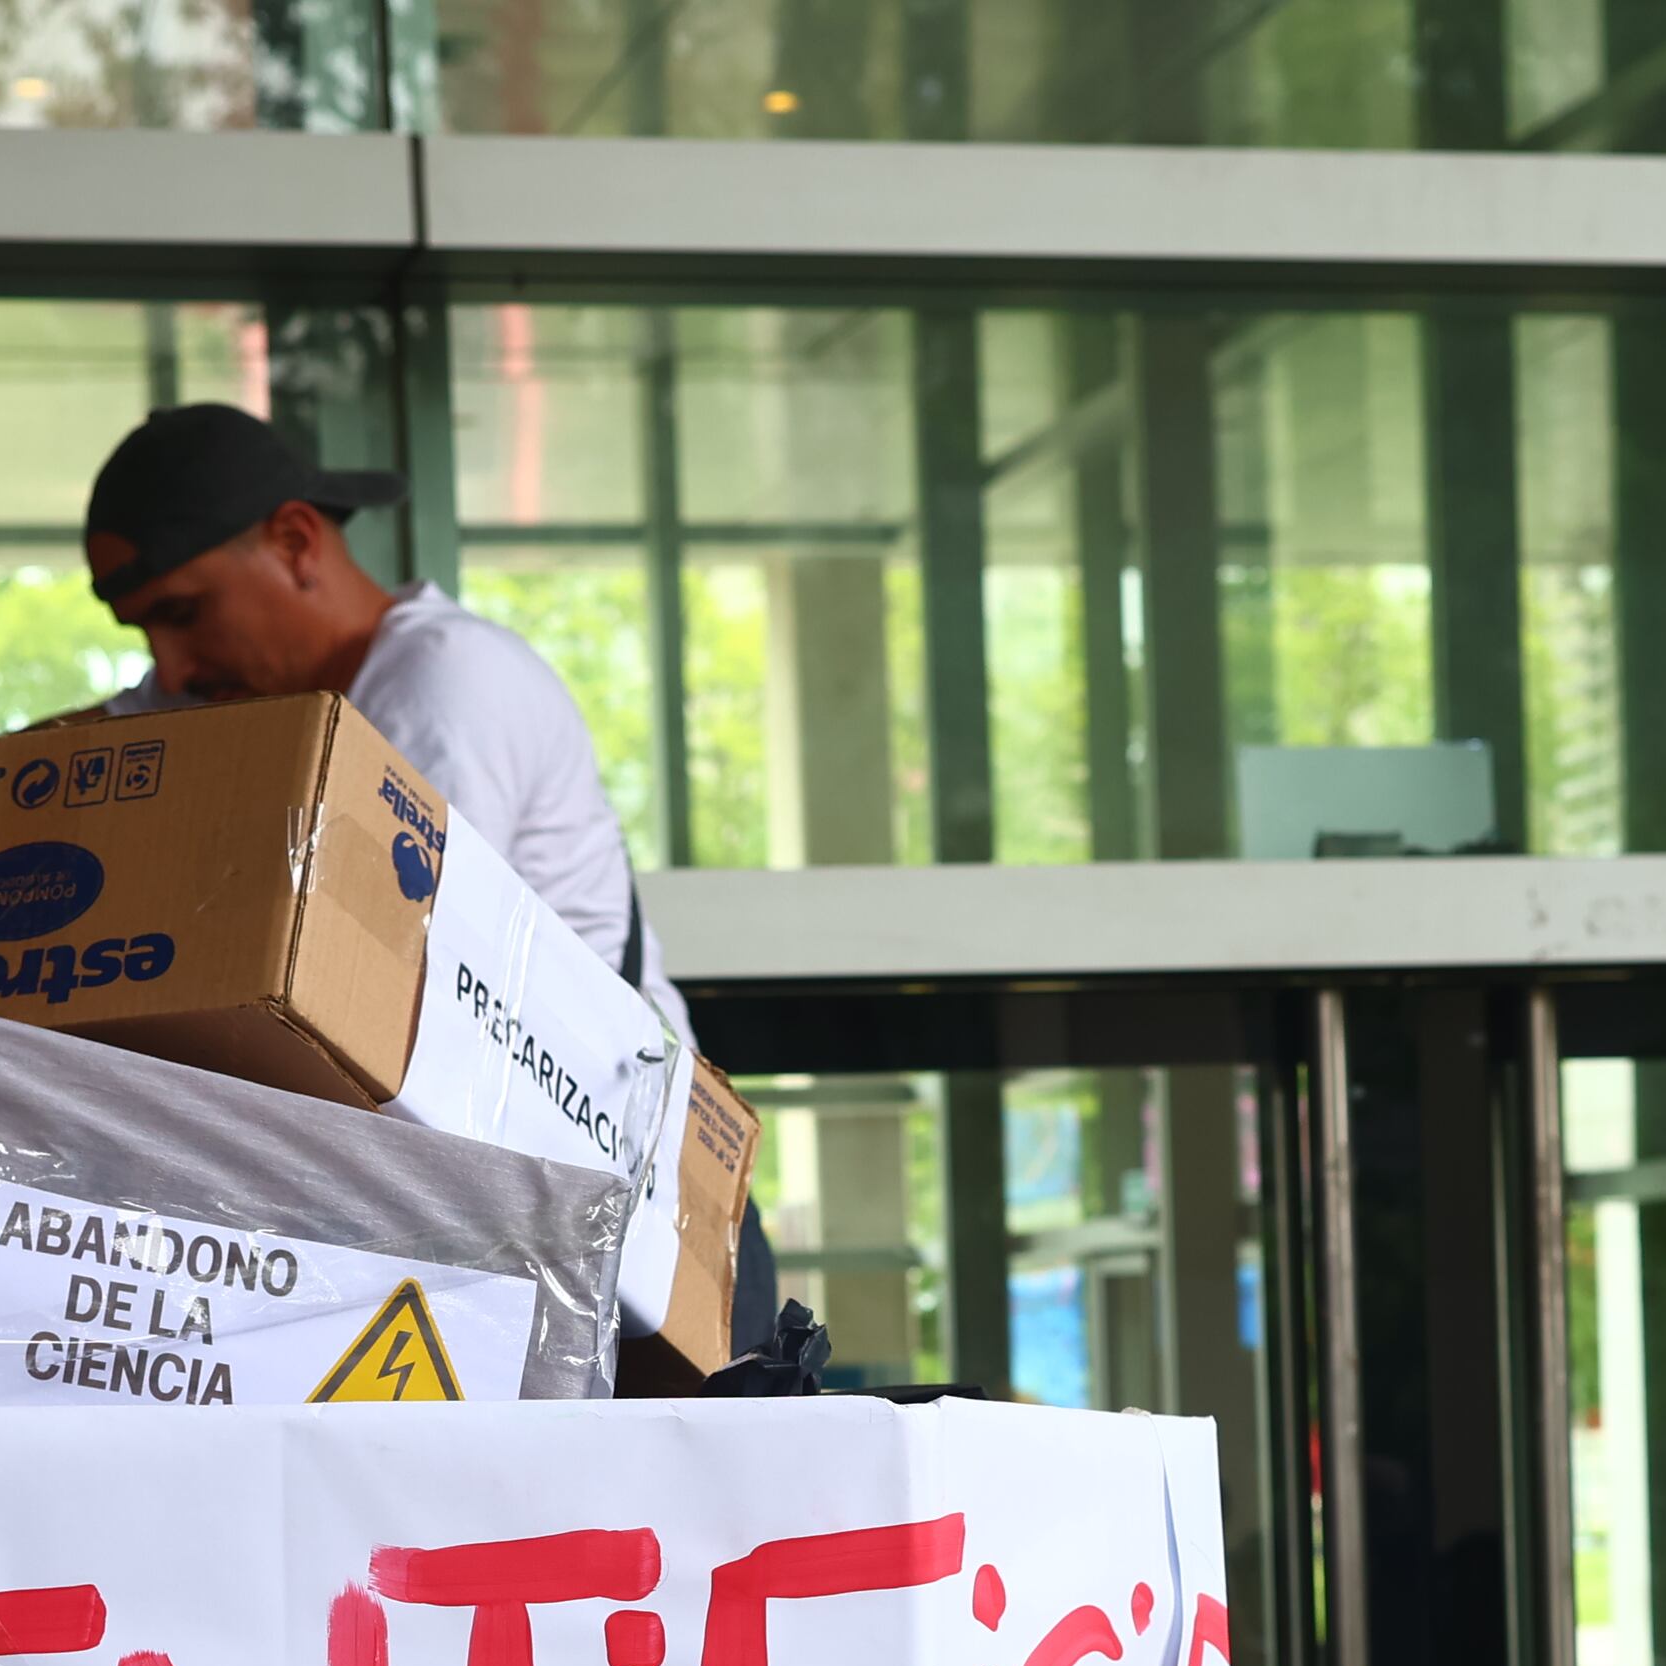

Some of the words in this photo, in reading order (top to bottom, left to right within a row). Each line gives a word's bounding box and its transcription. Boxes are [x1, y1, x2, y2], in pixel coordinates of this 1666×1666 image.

[65, 1274, 132, 1330] DE
[149, 1288, 213, 1346] LA
[25, 1331, 233, 1406] CIENCIA
